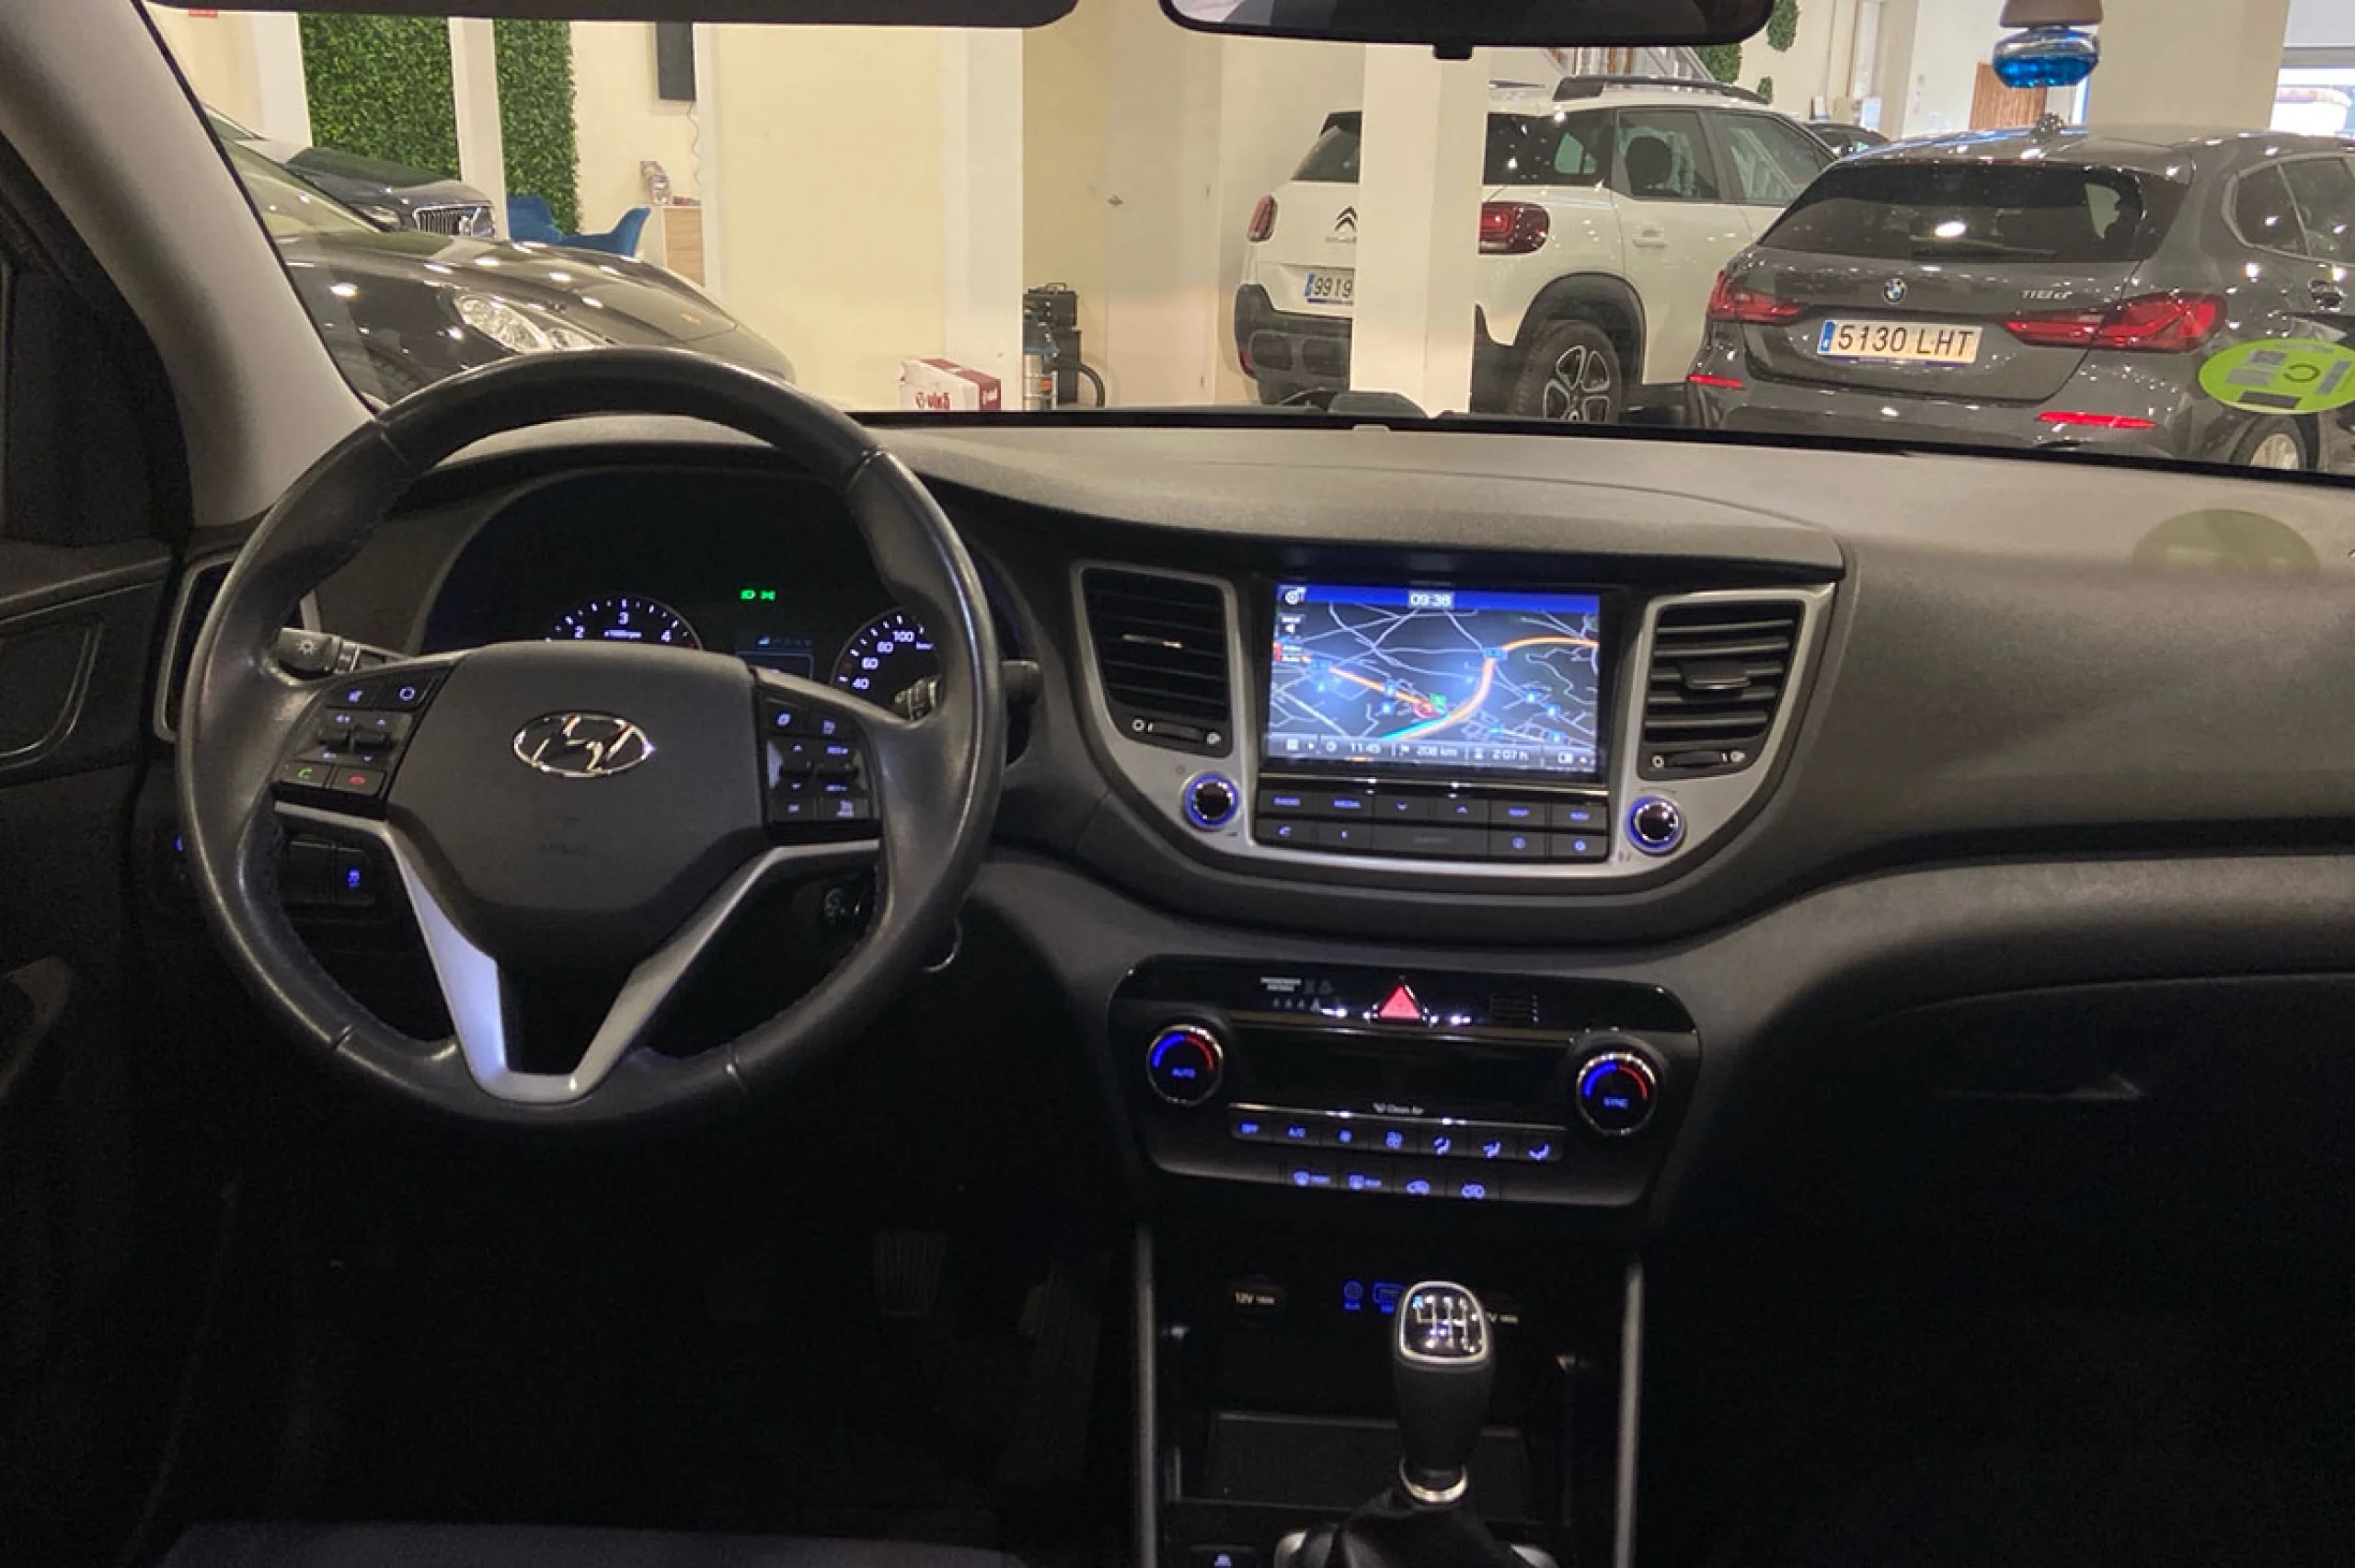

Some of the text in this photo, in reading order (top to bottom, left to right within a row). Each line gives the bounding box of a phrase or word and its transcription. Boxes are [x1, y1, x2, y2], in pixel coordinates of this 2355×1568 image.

[1838, 324, 1974, 358] 5130 LHT
[1409, 591, 1453, 608] 09:38
[618, 612, 629, 625] 3
[574, 625, 585, 639] 2
[661, 629, 672, 643] 4
[892, 630, 915, 643] 100
[877, 641, 894, 653] 80
[861, 657, 879, 670] 60
[852, 677, 870, 690] 40
